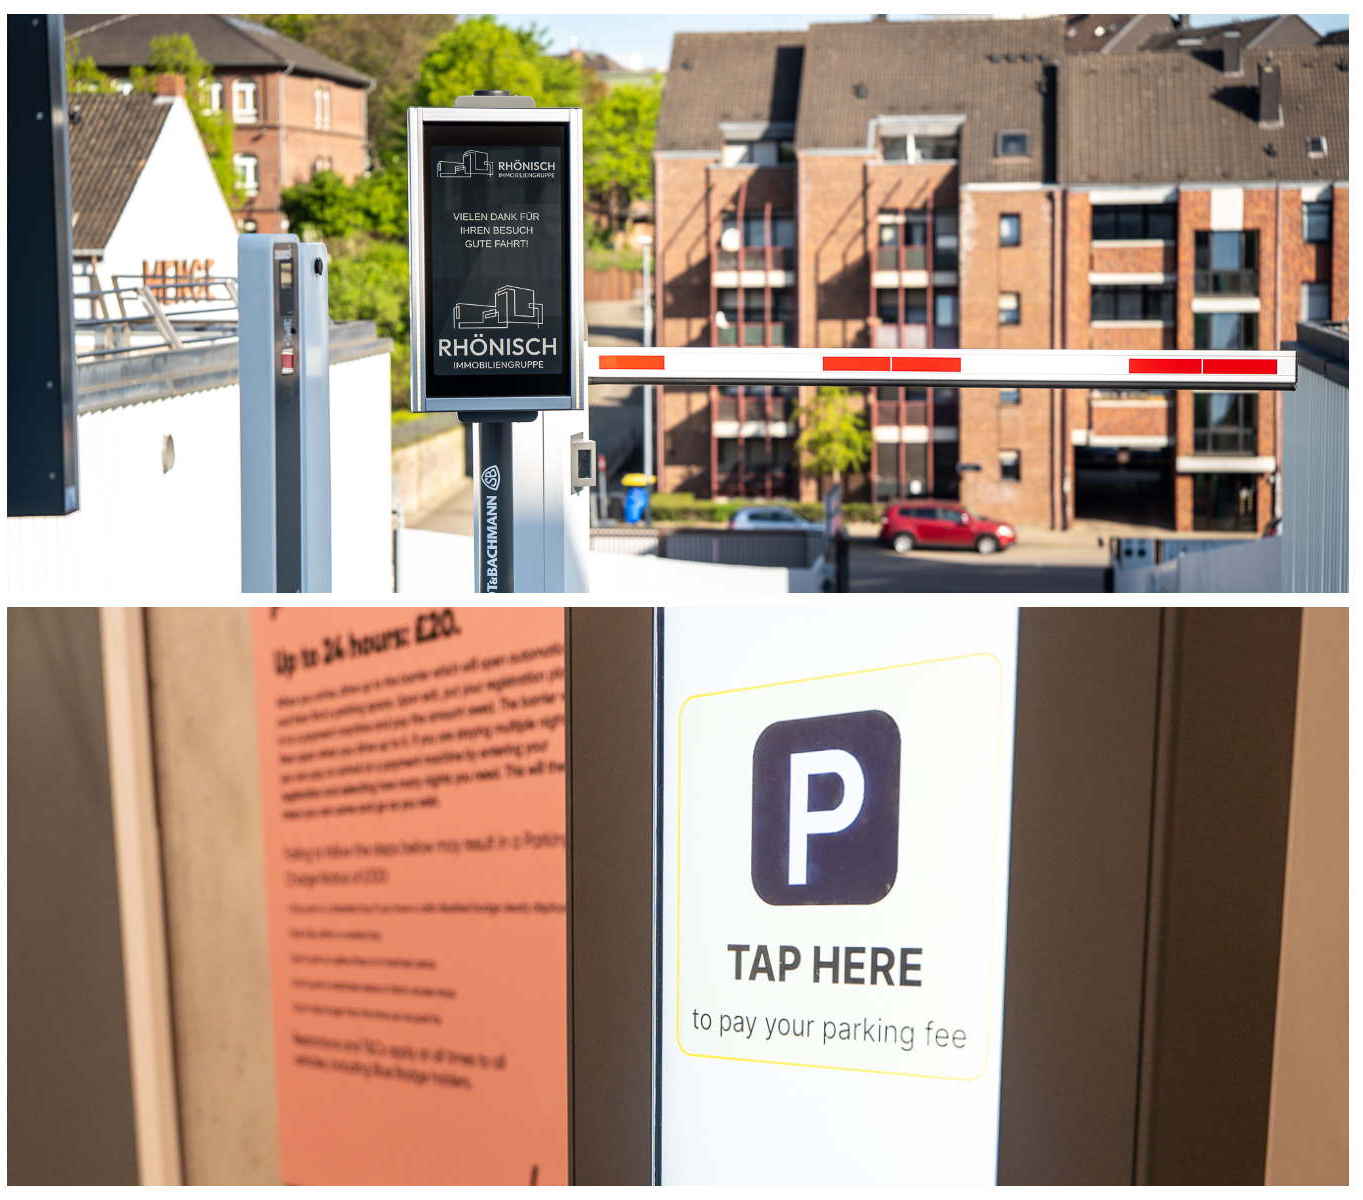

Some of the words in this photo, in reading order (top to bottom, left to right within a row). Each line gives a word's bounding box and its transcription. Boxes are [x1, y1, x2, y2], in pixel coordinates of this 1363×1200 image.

[498, 159, 556, 171] RHÖNISCH
[452, 212, 488, 221] VIELEN
[490, 212, 518, 221] DANK
[520, 211, 540, 221] FÜR
[460, 226, 491, 235] IHREN
[492, 226, 534, 235] BESUCH
[464, 239, 492, 248] GUTE
[494, 239, 529, 248] FAHRT!
[439, 334, 556, 356] RHÖNISCH
[453, 360, 544, 369] IMMOBILIENGRUPPE
[486, 495, 498, 593] T&BACHMANN
[274, 648, 296, 679] Up
[301, 646, 318, 669] to
[323, 635, 344, 664] 24
[348, 627, 410, 657] hours:
[415, 608, 462, 643] £20.
[788, 749, 865, 886] P
[727, 944, 801, 982] TAP
[813, 946, 922, 987] HERE
[692, 1008, 712, 1031] to
[719, 1014, 757, 1040] pay
[765, 1017, 815, 1041] your
[823, 1017, 915, 1052] parking
[925, 1020, 967, 1049] fee
